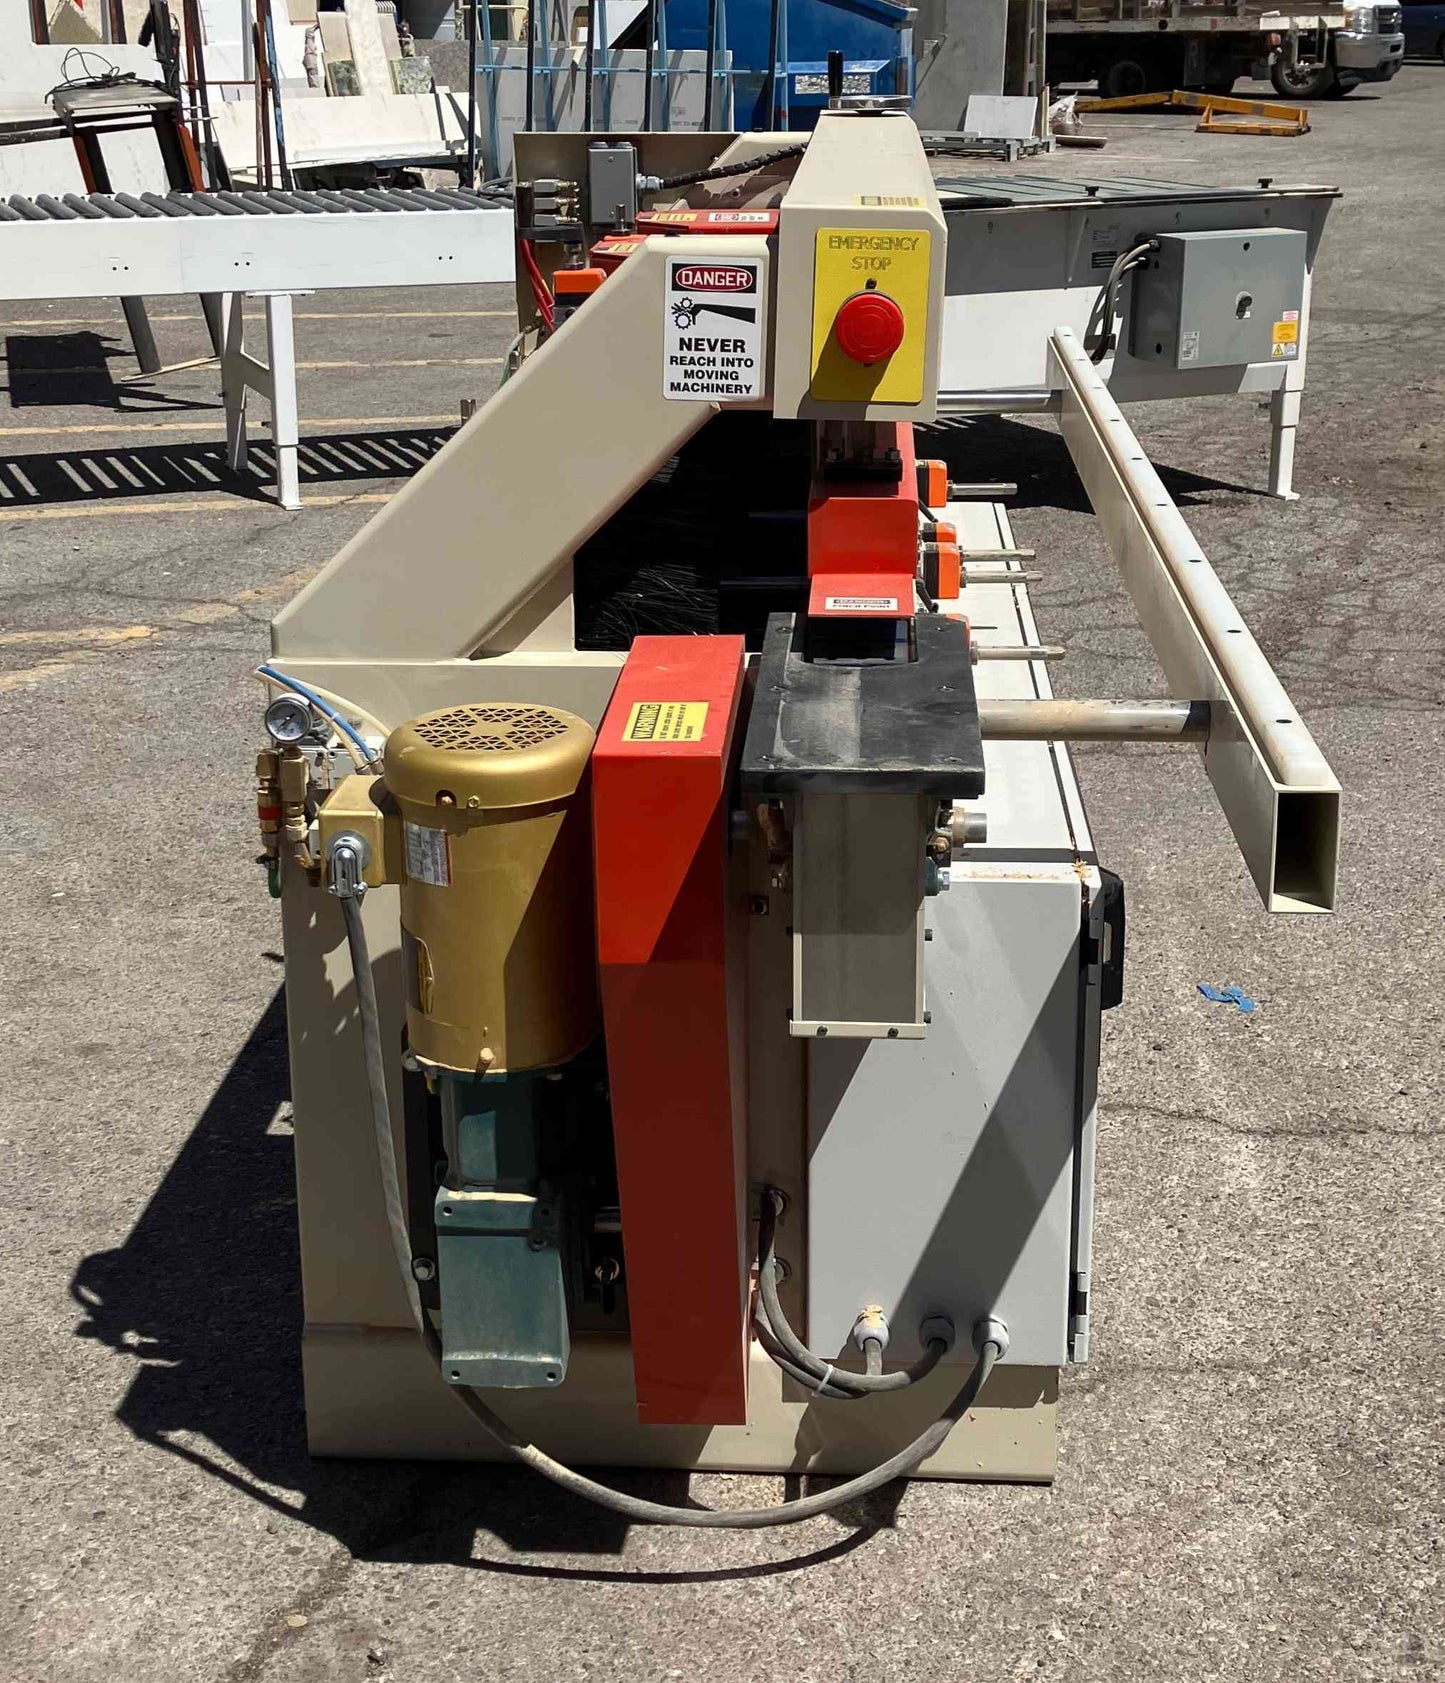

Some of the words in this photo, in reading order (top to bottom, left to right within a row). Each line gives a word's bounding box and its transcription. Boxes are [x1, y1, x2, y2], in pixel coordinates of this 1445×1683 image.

[828, 235, 919, 251] EMERGENCY
[851, 256, 892, 271] STOP
[681, 270, 748, 287] DANGER
[679, 337, 746, 353] NEVER
[669, 355, 716, 367] REACH
[720, 357, 754, 369] INTO
[683, 369, 740, 380] MOVING
[669, 382, 753, 394] MACHINERY
[630, 704, 661, 739] WARNING
